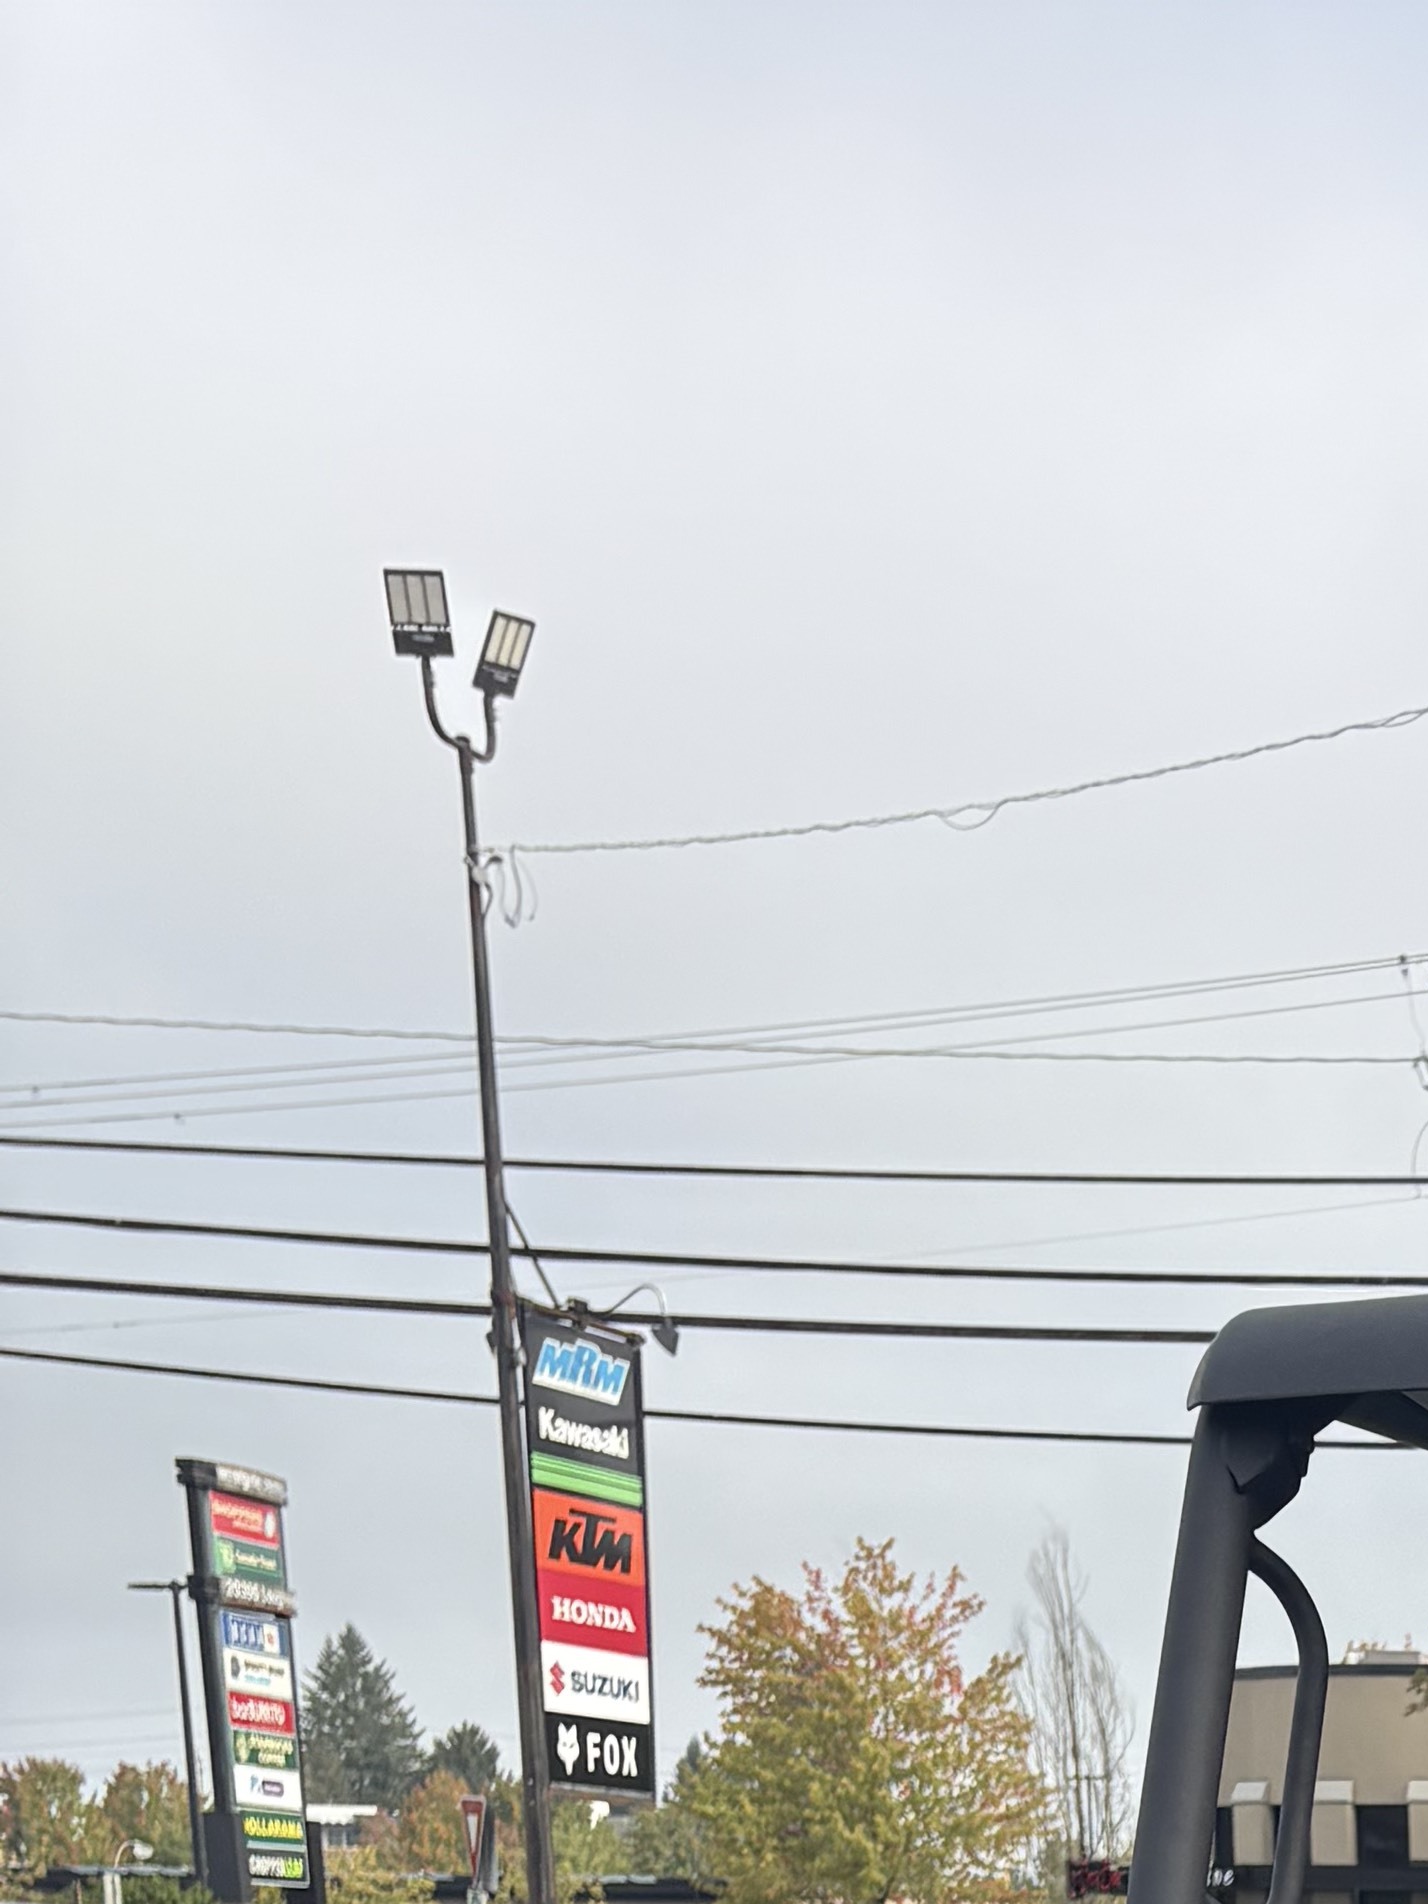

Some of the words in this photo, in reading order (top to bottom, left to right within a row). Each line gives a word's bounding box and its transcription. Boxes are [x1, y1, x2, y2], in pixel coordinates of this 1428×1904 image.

[536, 1340, 627, 1398] MRM
[538, 1406, 630, 1459] Kawasaki
[548, 1508, 633, 1575] KTM
[551, 1595, 636, 1634] HONDA
[571, 1669, 640, 1702] SUZUKI
[586, 1731, 638, 1777] FOX
